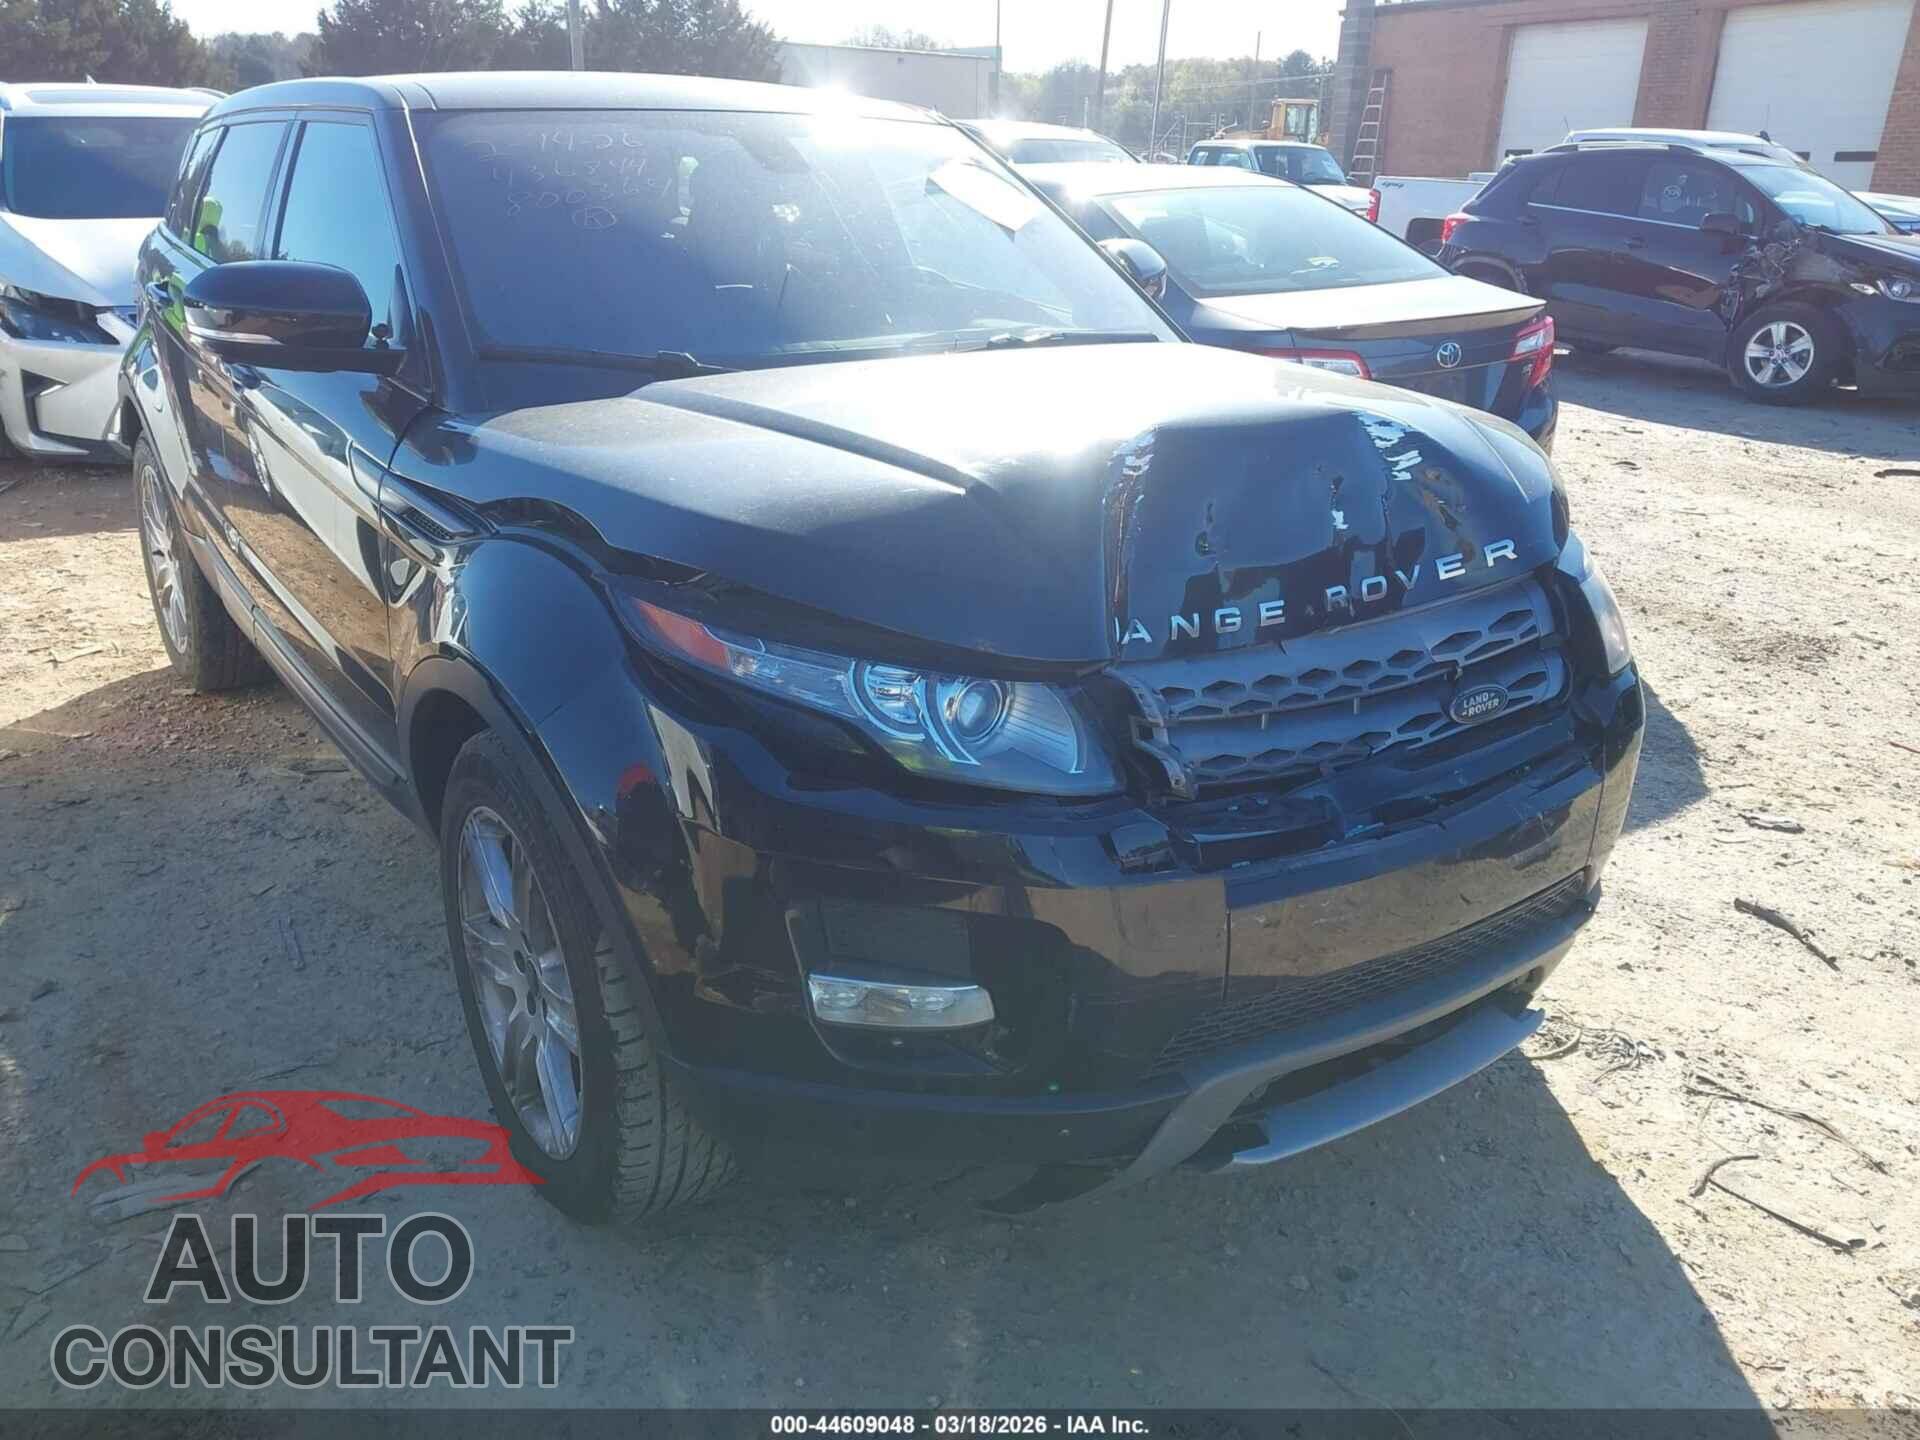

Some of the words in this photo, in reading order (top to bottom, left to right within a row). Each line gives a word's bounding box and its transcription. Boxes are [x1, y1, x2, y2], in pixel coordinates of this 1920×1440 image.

[1113, 599, 1286, 646] ANGE
[1325, 538, 1517, 613] ROVER
[1463, 692, 1489, 709] LAND
[1468, 698, 1500, 717] ROVER
